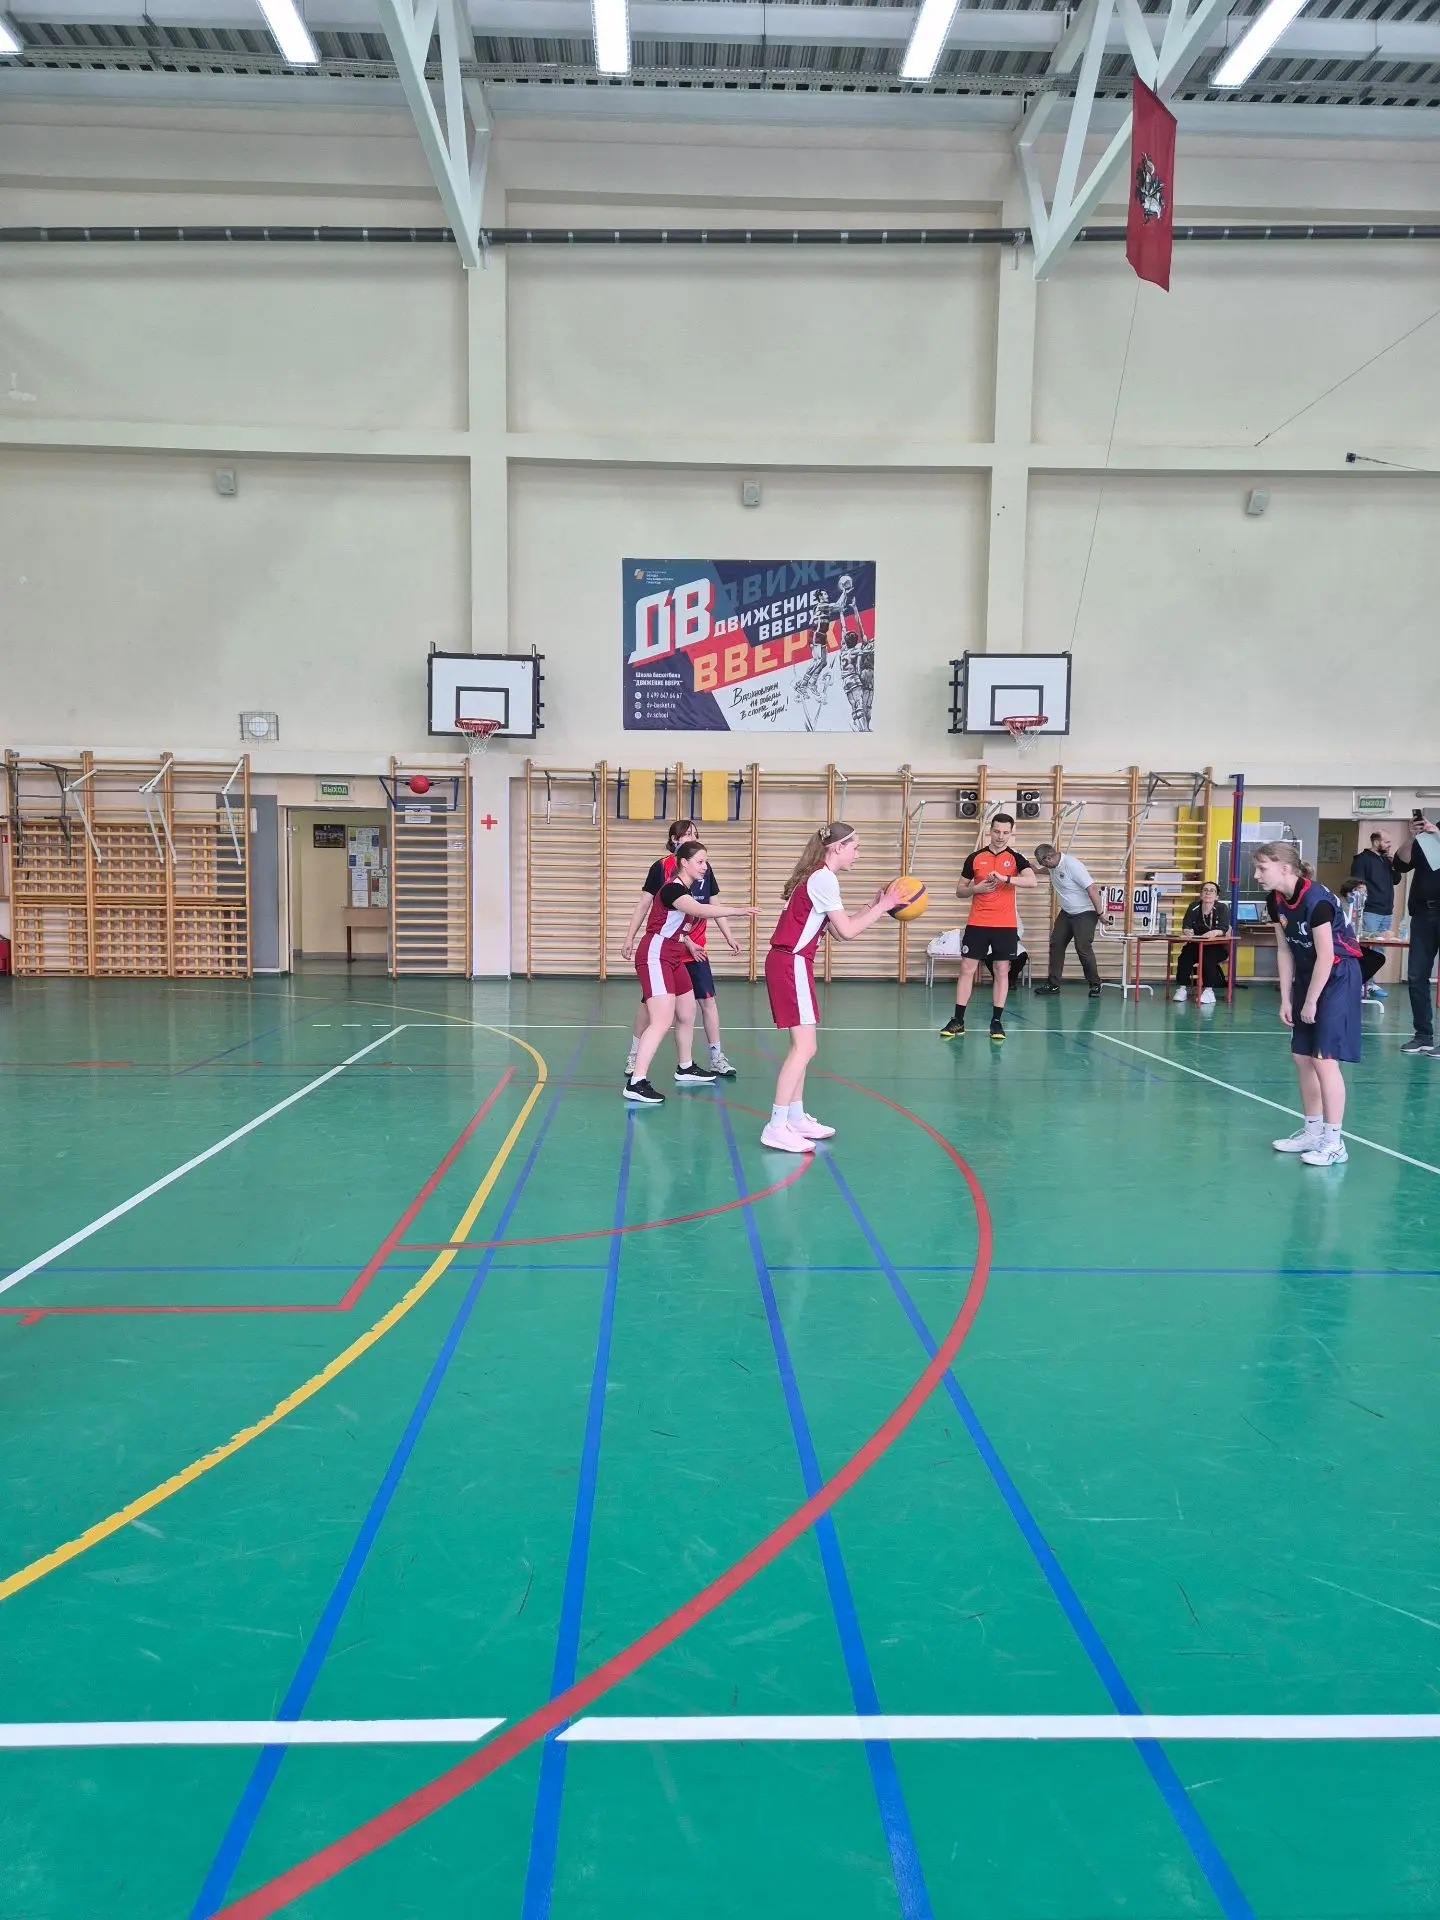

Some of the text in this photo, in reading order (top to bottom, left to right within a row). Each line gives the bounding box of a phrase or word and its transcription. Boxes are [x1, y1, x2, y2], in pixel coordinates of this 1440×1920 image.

[714, 589, 819, 637] ДВИЖЕНИЕ
[628, 578, 711, 664] ДВ
[322, 785, 347, 795] ВЫХОД
[698, 878, 705, 890] 7
[1110, 887, 1124, 903] 02
[1134, 889, 1148, 903] 00
[1143, 917, 1148, 927] 0
